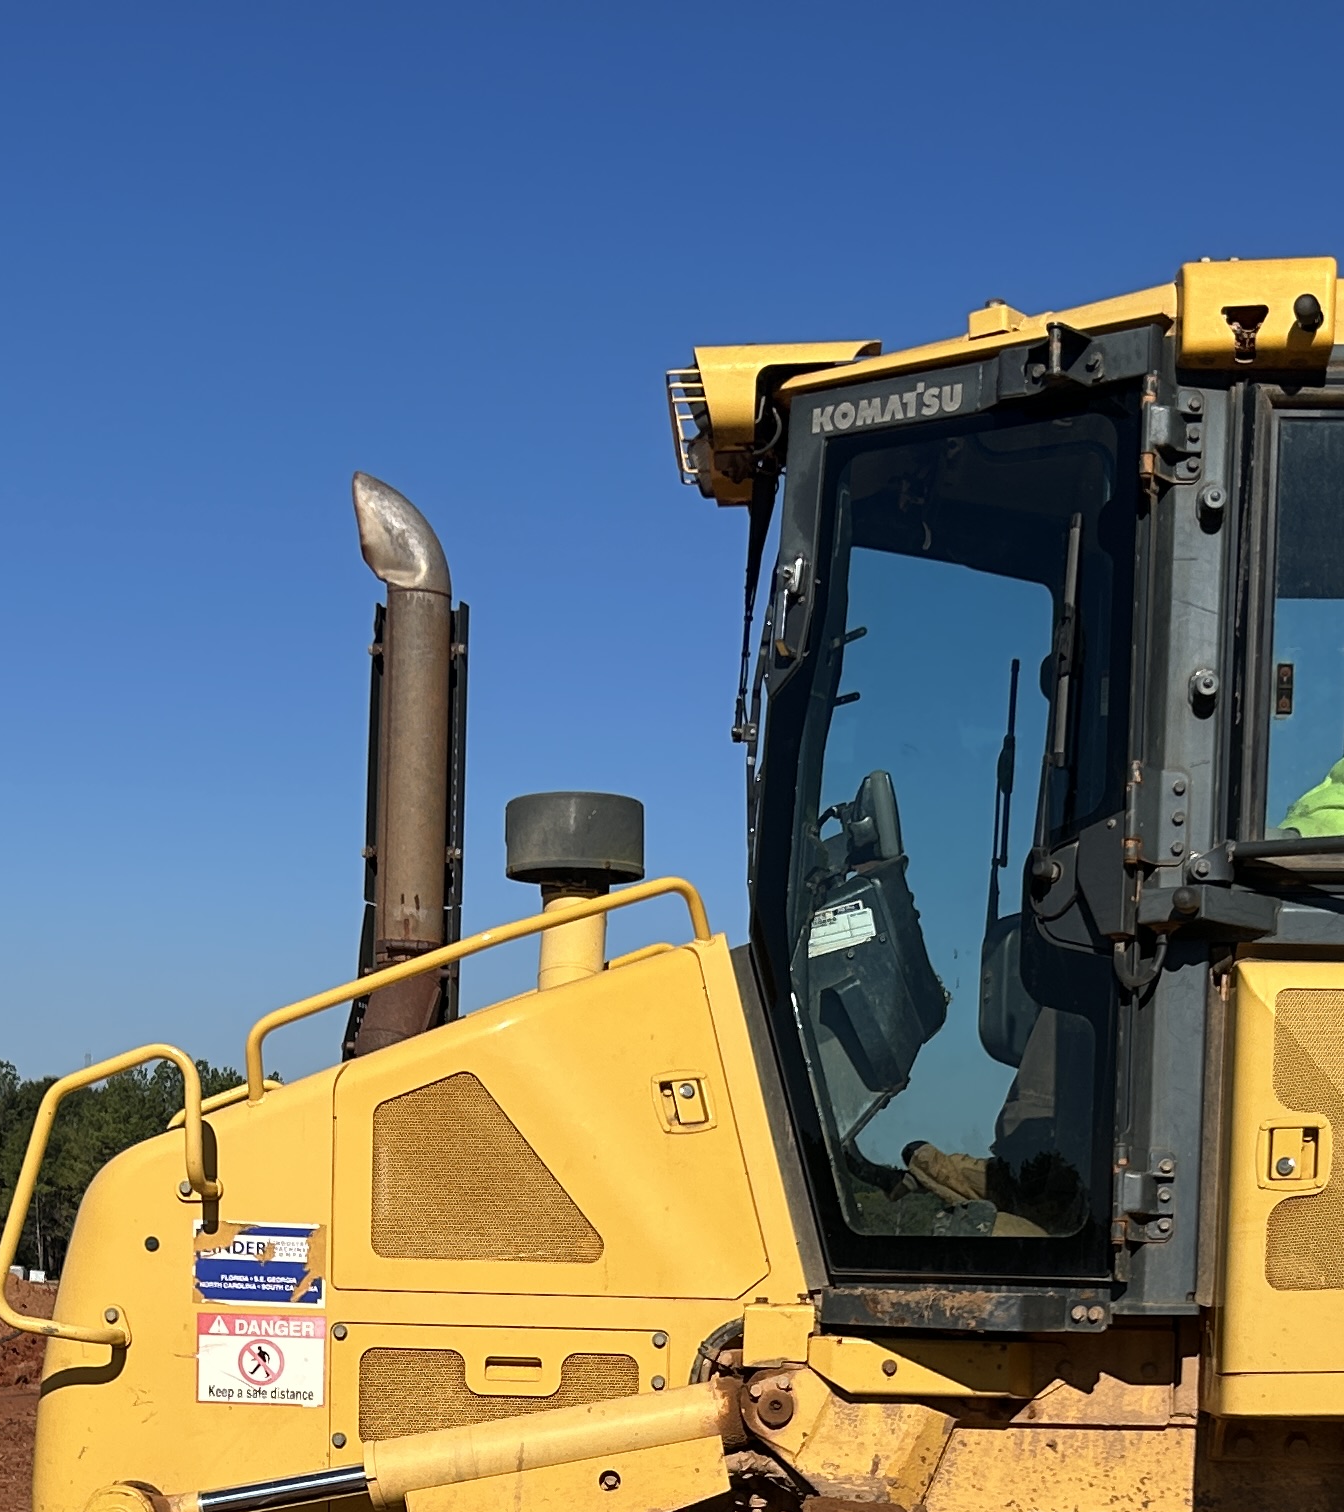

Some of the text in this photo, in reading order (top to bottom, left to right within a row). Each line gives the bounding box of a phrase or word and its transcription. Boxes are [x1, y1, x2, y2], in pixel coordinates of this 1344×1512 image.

[811, 382, 963, 434] KOMATSU
[234, 1319, 315, 1337] DANGER
[208, 1384, 314, 1401] Keep a safe distance
